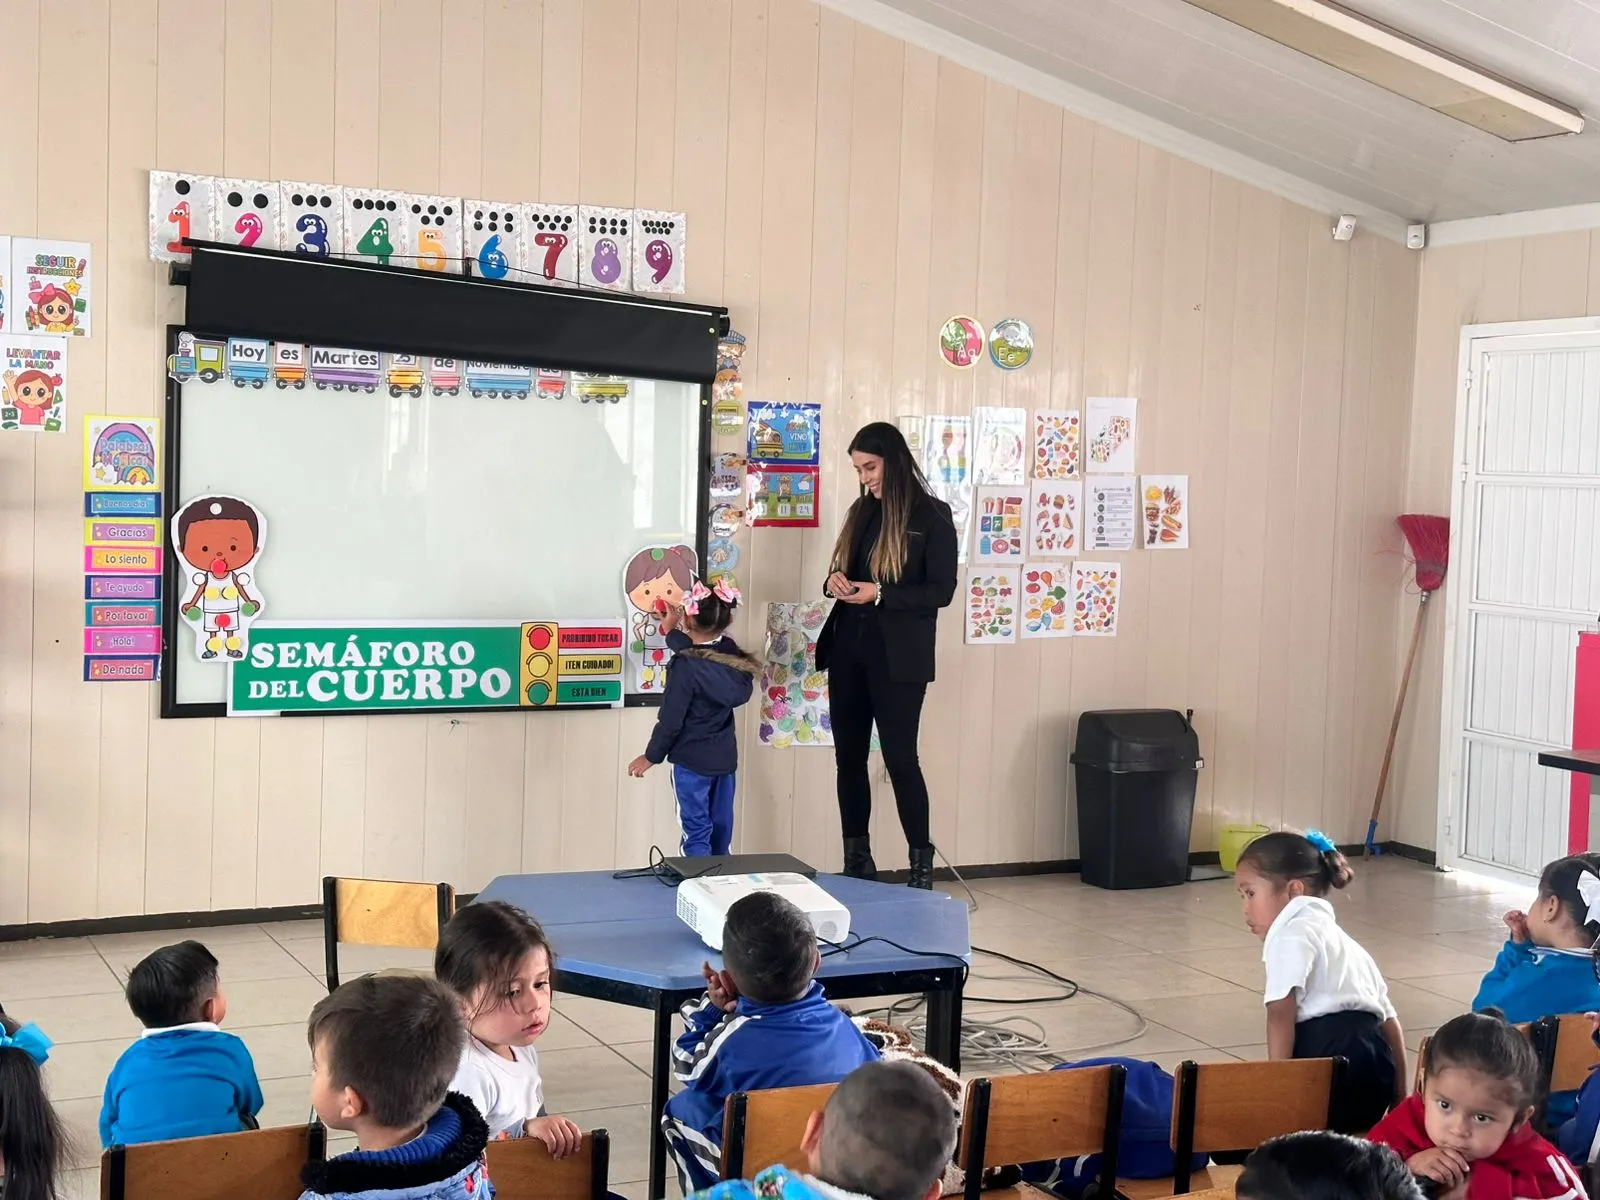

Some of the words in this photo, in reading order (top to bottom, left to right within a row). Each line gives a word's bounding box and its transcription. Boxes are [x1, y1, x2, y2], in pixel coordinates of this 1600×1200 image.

[166, 201, 193, 254] 1
[234, 212, 263, 249] 2
[296, 213, 330, 259] 3
[356, 217, 394, 266] 4
[35, 253, 76, 269] SEGUIR
[417, 228, 447, 274] 5
[478, 234, 509, 280] 6
[534, 232, 568, 281] 7
[591, 237, 622, 284] 8
[645, 239, 673, 285] 9
[6, 348, 61, 360] LEVANTAR
[9, 359, 22, 368] LA
[25, 360, 54, 370] MANO
[232, 344, 265, 361] Hoy
[280, 349, 299, 360] es
[313, 350, 378, 366] Martes
[108, 527, 147, 537] Gracias
[105, 553, 117, 564] Lo
[119, 554, 148, 564] siento
[106, 582, 116, 592] Te
[118, 582, 144, 594] ayudo
[106, 611, 120, 620] Por
[123, 611, 148, 620] favor
[103, 664, 115, 674] De
[118, 665, 144, 674] nada
[250, 634, 475, 669] SEMÁFORO
[248, 680, 304, 699] DEL
[306, 667, 511, 702] CUERPO
